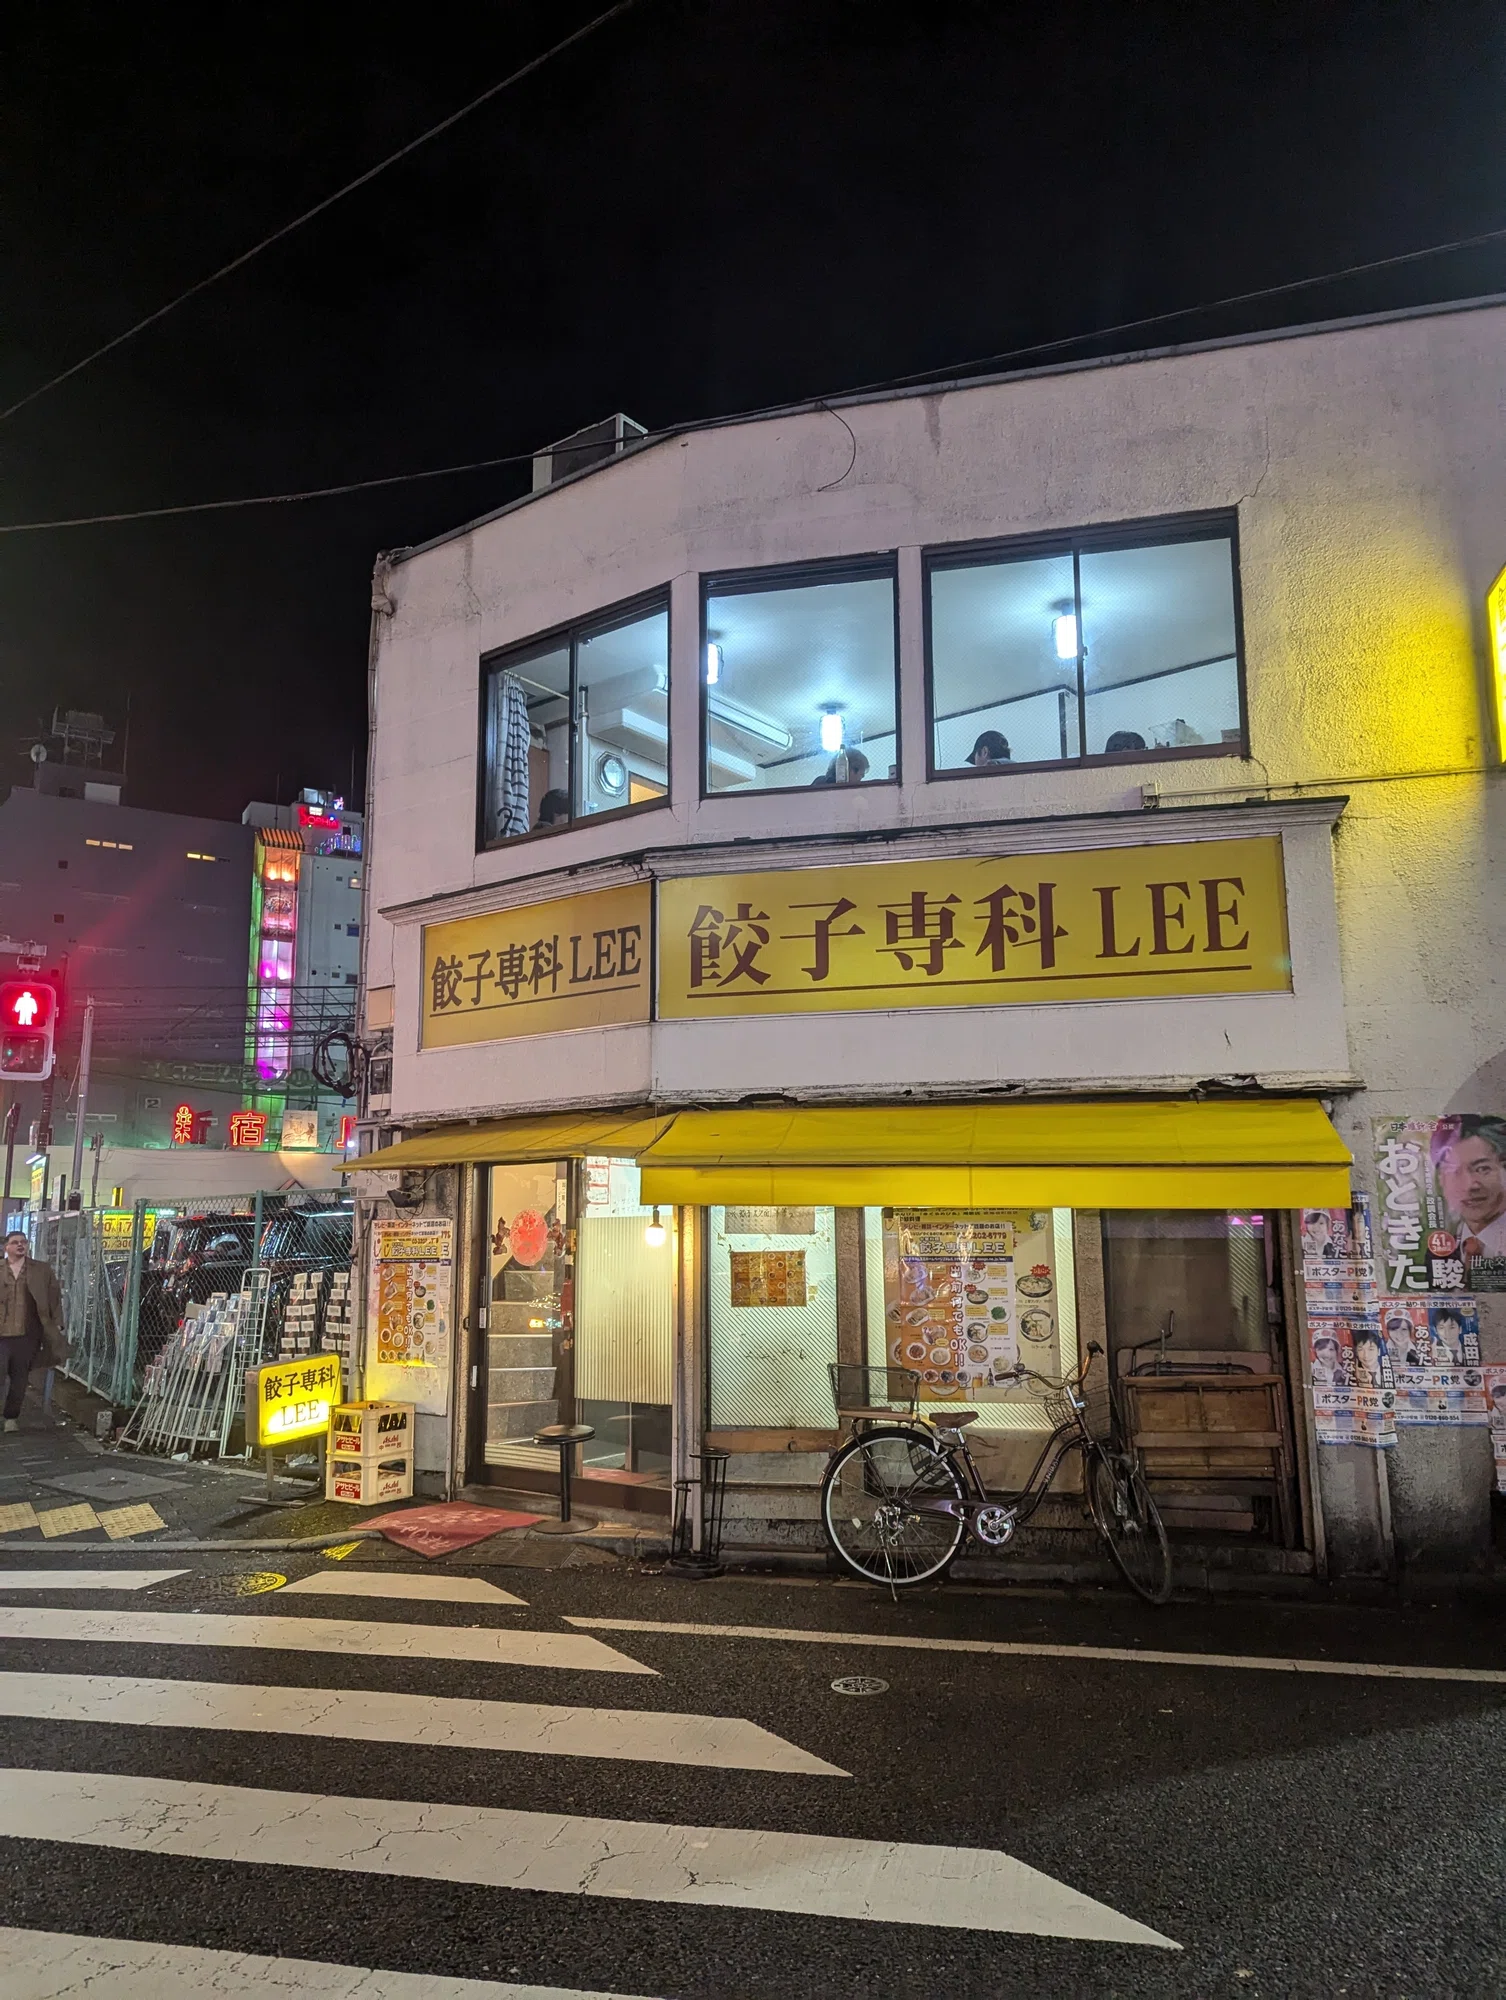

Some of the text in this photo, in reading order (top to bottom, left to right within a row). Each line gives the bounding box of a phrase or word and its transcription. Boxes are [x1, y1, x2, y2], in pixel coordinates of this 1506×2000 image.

[689, 876, 1250, 987] 餃子専科 LEE
[431, 924, 642, 1011] 餃子専科 LEE
[1378, 1138, 1429, 1290] おときた
[1332, 1220, 1348, 1258] あなた
[1431, 1259, 1466, 1289] 駿
[1469, 1256, 1506, 1270] 世代交
[1415, 1325, 1433, 1366] あなた
[264, 1364, 336, 1402] 餃子専科
[1341, 1346, 1358, 1386] あなた
[1395, 1374, 1461, 1386] ポスターPR党
[281, 1399, 321, 1427] LEE
[1321, 1394, 1380, 1408] ポスターPR党
[336, 1436, 361, 1446] アサヒビール
[335, 1482, 361, 1492] アサヒビール
